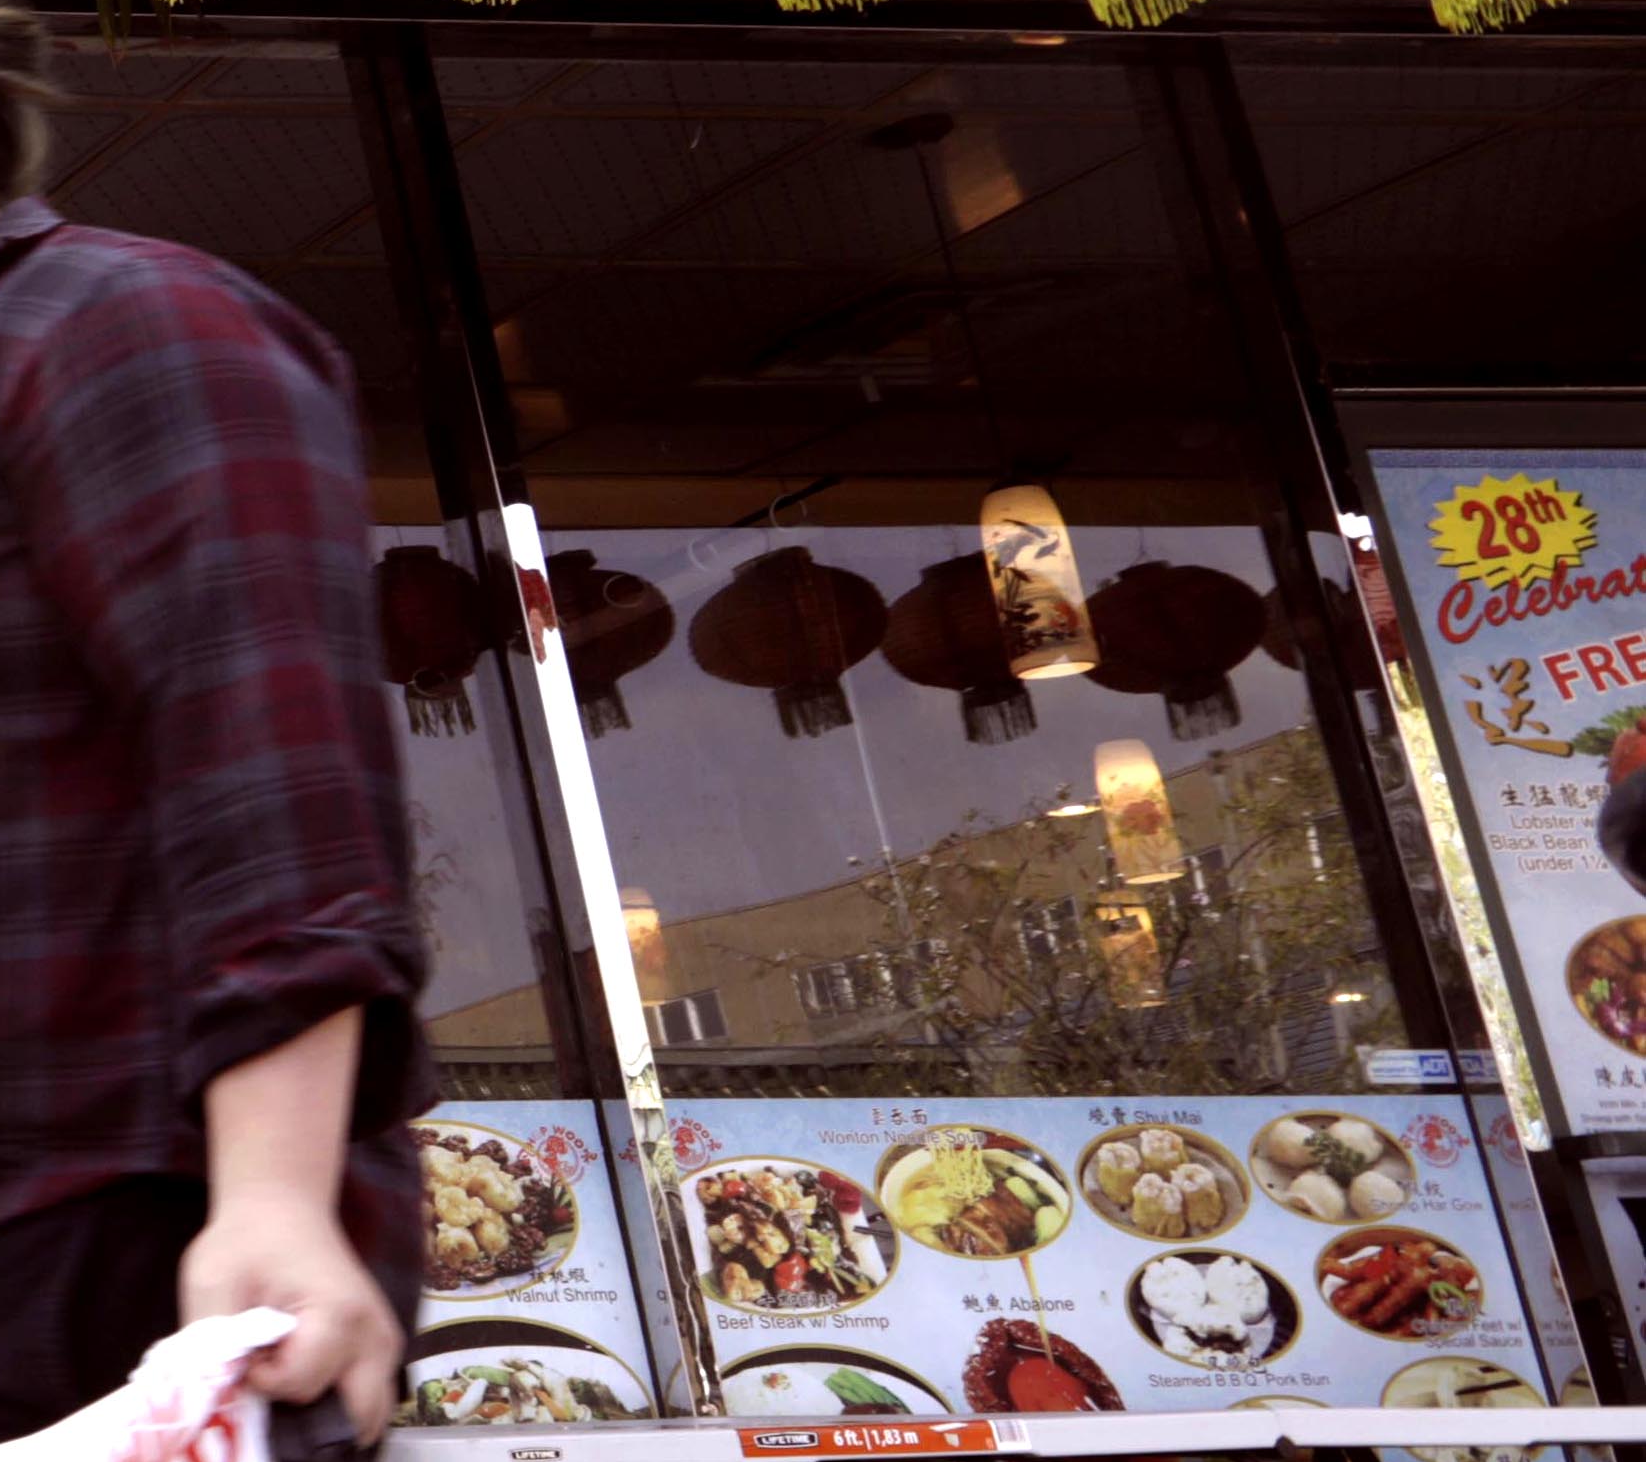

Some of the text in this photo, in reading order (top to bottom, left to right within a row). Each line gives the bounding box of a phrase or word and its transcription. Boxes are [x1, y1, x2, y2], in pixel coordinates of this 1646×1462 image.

[1460, 490, 1567, 563] 28th
[1463, 657, 1573, 757] 送
[1511, 816, 1576, 829] Lobster
[1490, 835, 1589, 850] Black Bean
[1518, 856, 1574, 873] (under
[1134, 1110, 1203, 1125] Shui Mai
[552, 1124, 584, 1150] WOO
[818, 1129, 880, 1145] Wonton
[884, 1129, 940, 1145] Noodle
[505, 1289, 617, 1307] Walnut Shrimp
[1010, 1296, 1075, 1312] Abalone
[717, 1314, 890, 1333] Beef Steak w/ Shrimp
[1472, 1319, 1503, 1332] Feet
[1479, 1336, 1522, 1348] Sauce
[1147, 1374, 1211, 1387] Steamed
[1266, 1374, 1299, 1387] Pork
[1301, 1374, 1329, 1387] Bun
[759, 1433, 813, 1445] LIFETIME
[514, 1450, 557, 1460] LIFETIME
